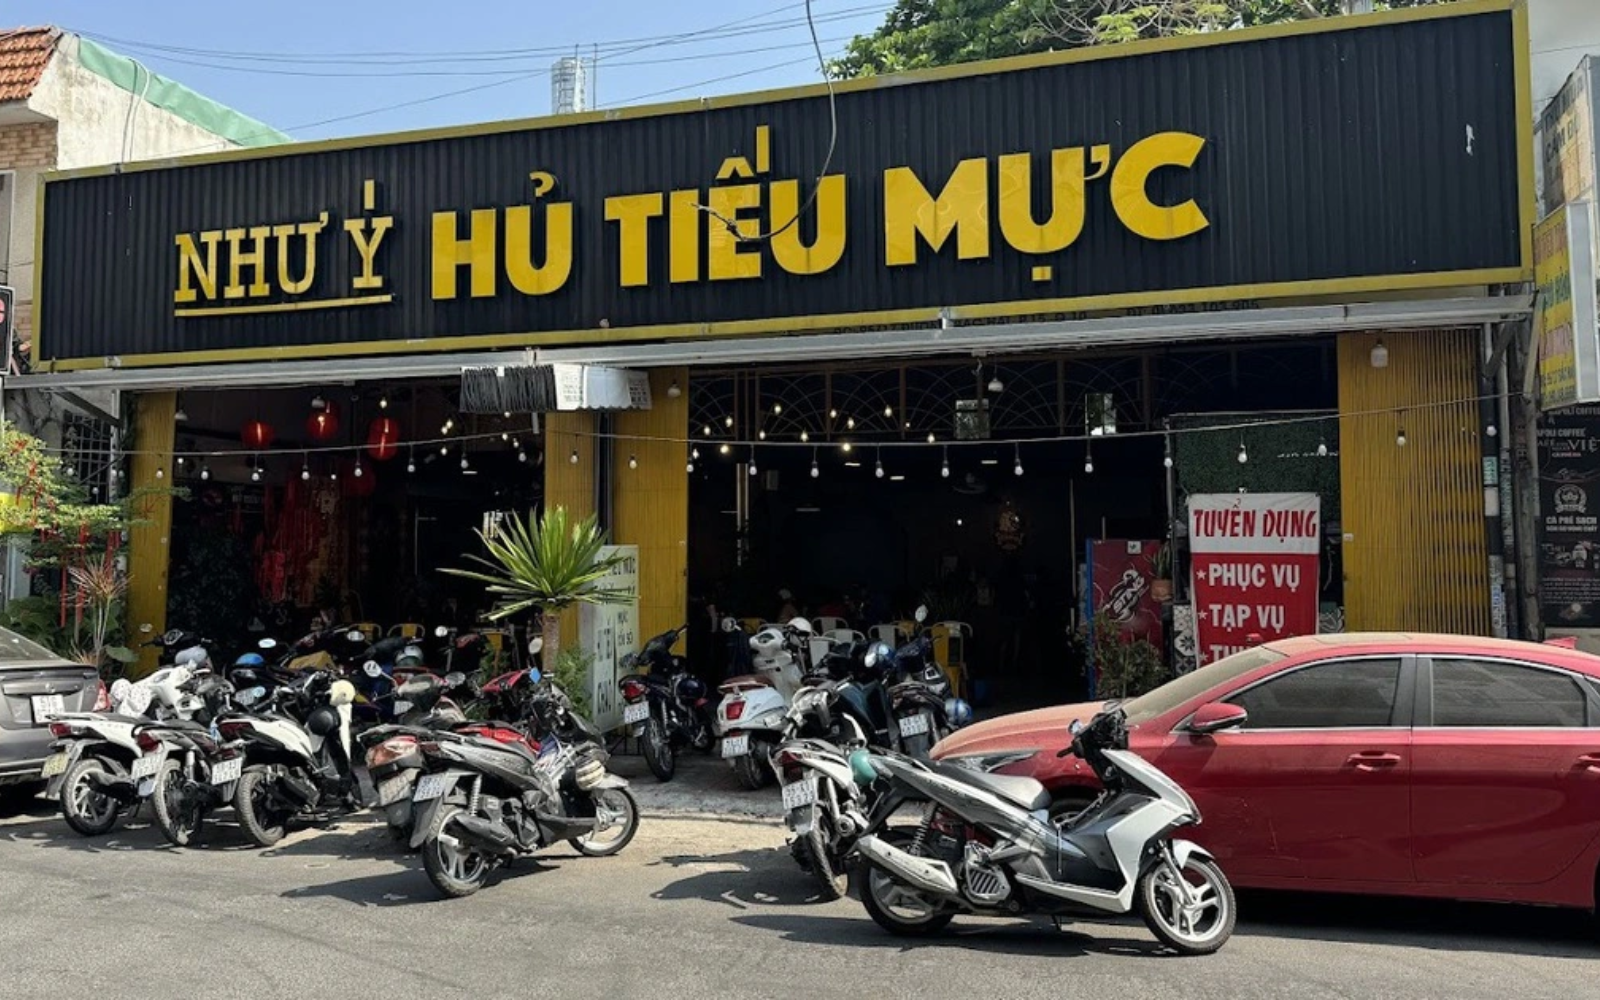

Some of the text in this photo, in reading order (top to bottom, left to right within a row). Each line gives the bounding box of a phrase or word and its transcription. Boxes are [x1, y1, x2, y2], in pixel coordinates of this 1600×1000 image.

[173, 125, 1210, 301] NHƯ Ý HỦ TIẾU MỰC
[1567, 436, 1600, 453] VIỆ
[1193, 498, 1317, 543] TUYỂN DỤNG
[1208, 563, 1300, 593] PHỤC VỤ
[1209, 604, 1285, 634] TẠP VỤ
